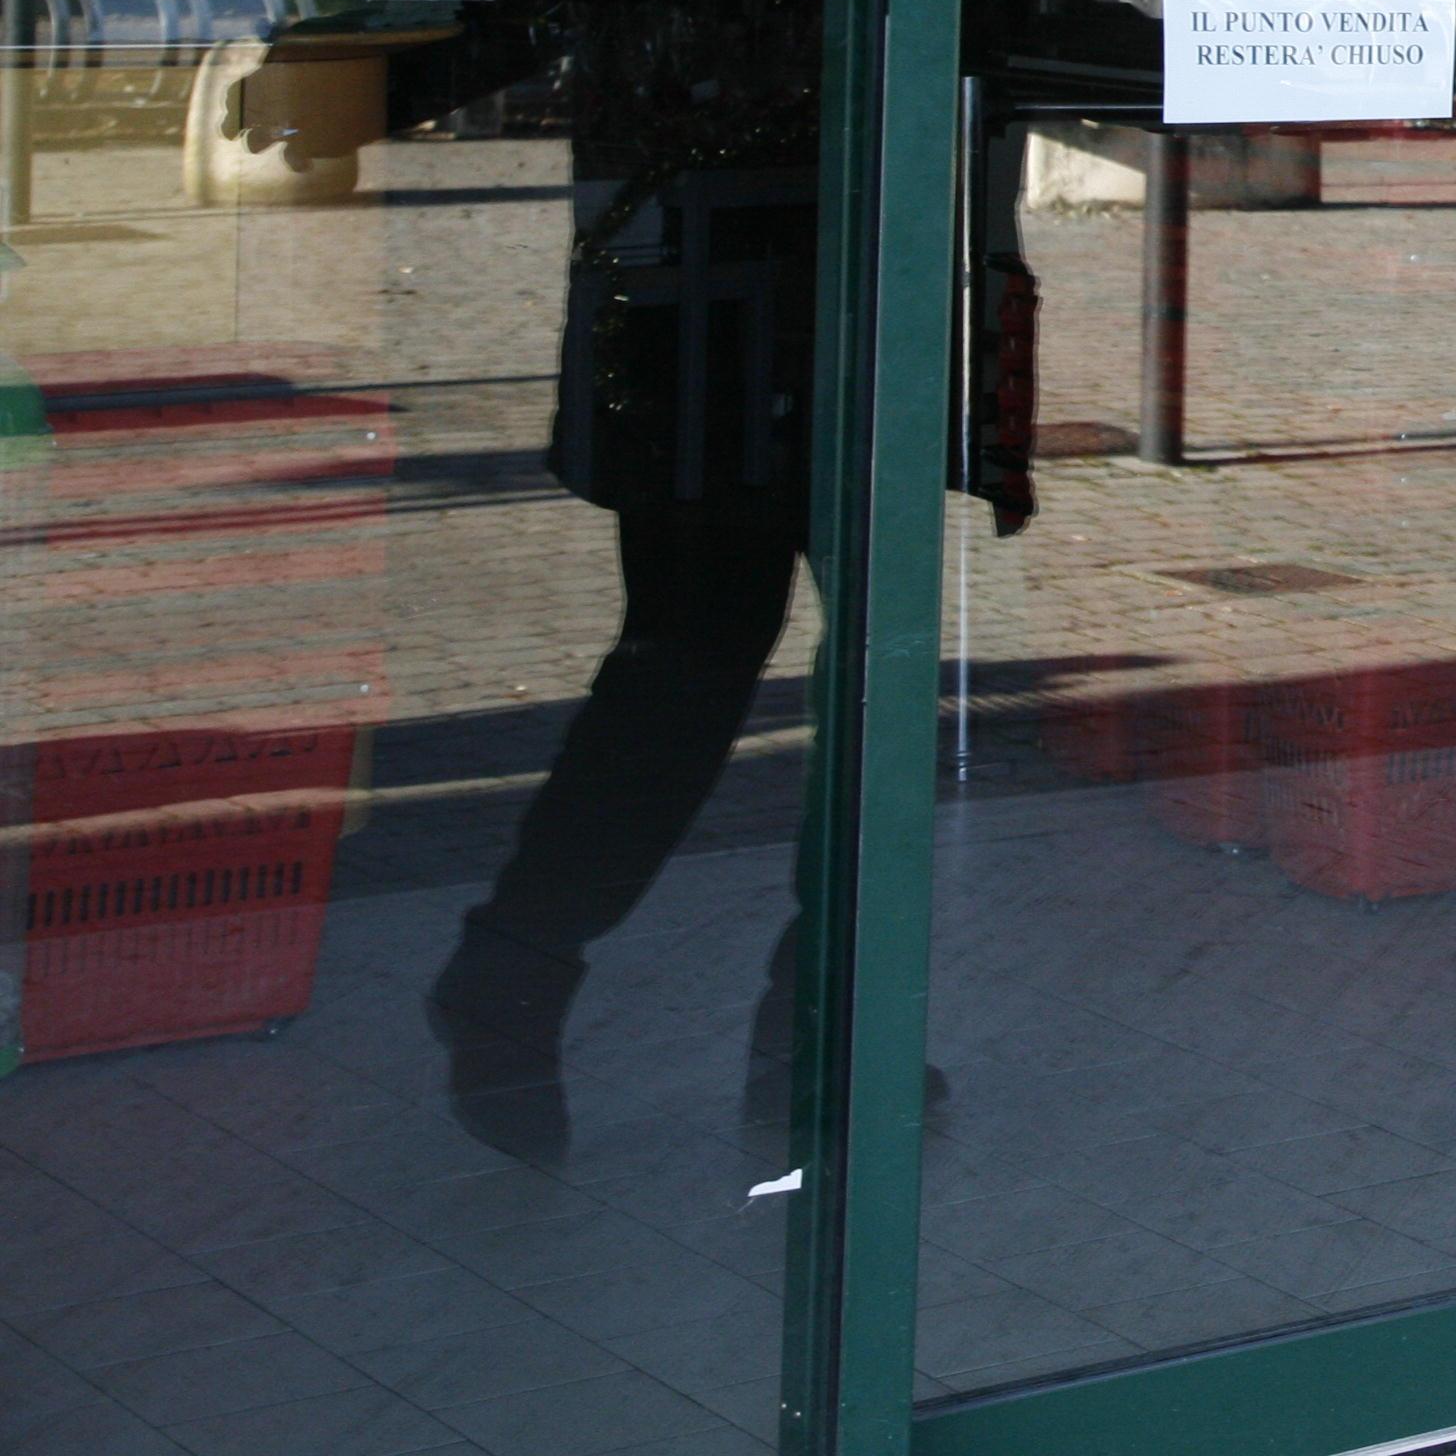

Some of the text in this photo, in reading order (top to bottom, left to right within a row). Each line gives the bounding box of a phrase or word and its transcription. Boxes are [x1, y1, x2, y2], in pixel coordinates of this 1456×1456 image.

[1191, 11, 1430, 33] IL PUNTO VENDITA
[1330, 44, 1424, 65] CHIUSO
